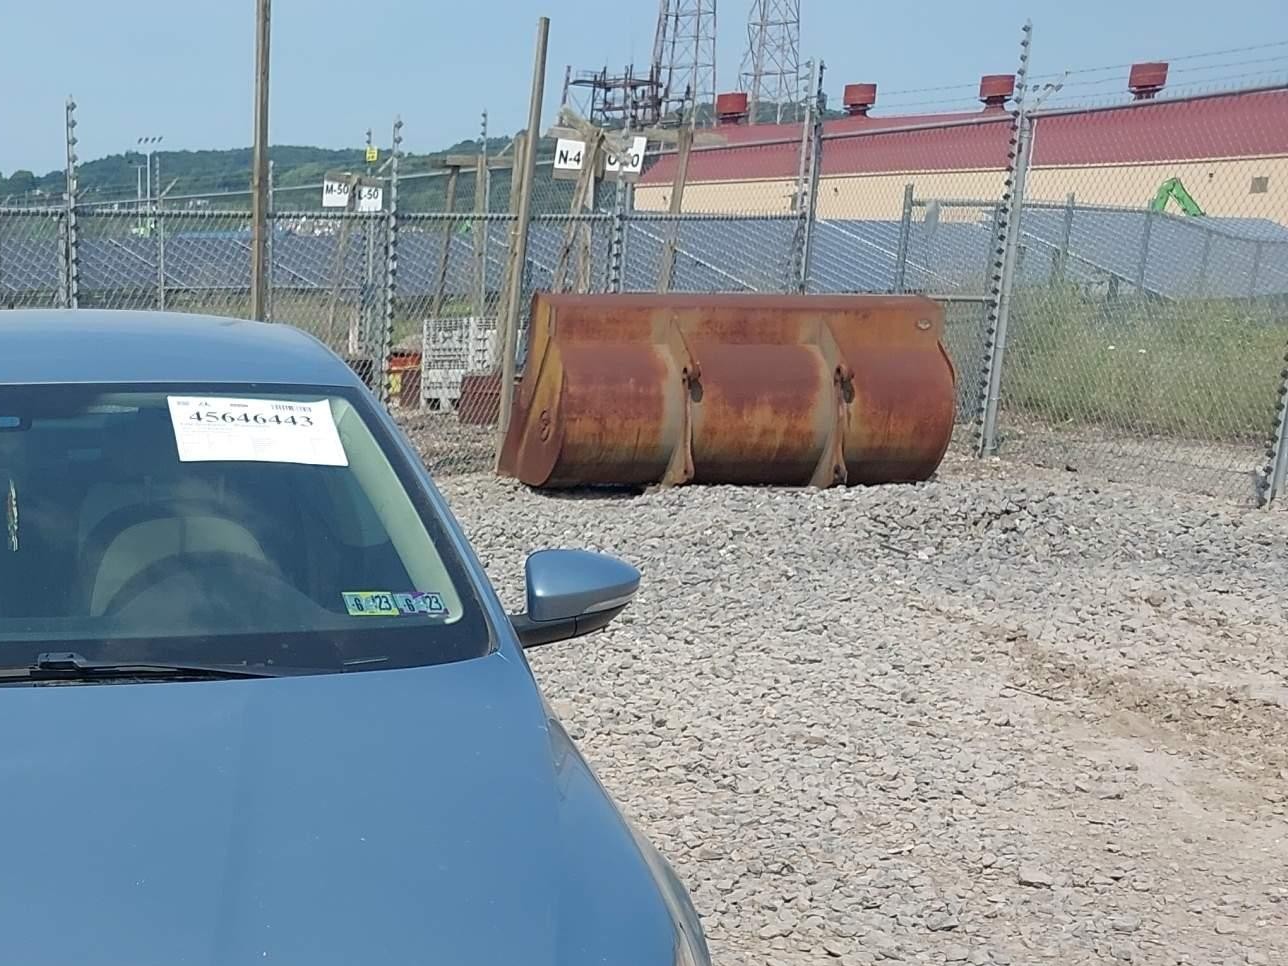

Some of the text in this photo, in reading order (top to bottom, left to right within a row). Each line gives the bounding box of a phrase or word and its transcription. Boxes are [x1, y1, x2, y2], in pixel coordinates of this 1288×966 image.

[325, 183, 349, 195] M-50
[358, 188, 379, 200] L-50
[189, 410, 314, 427] 45646443
